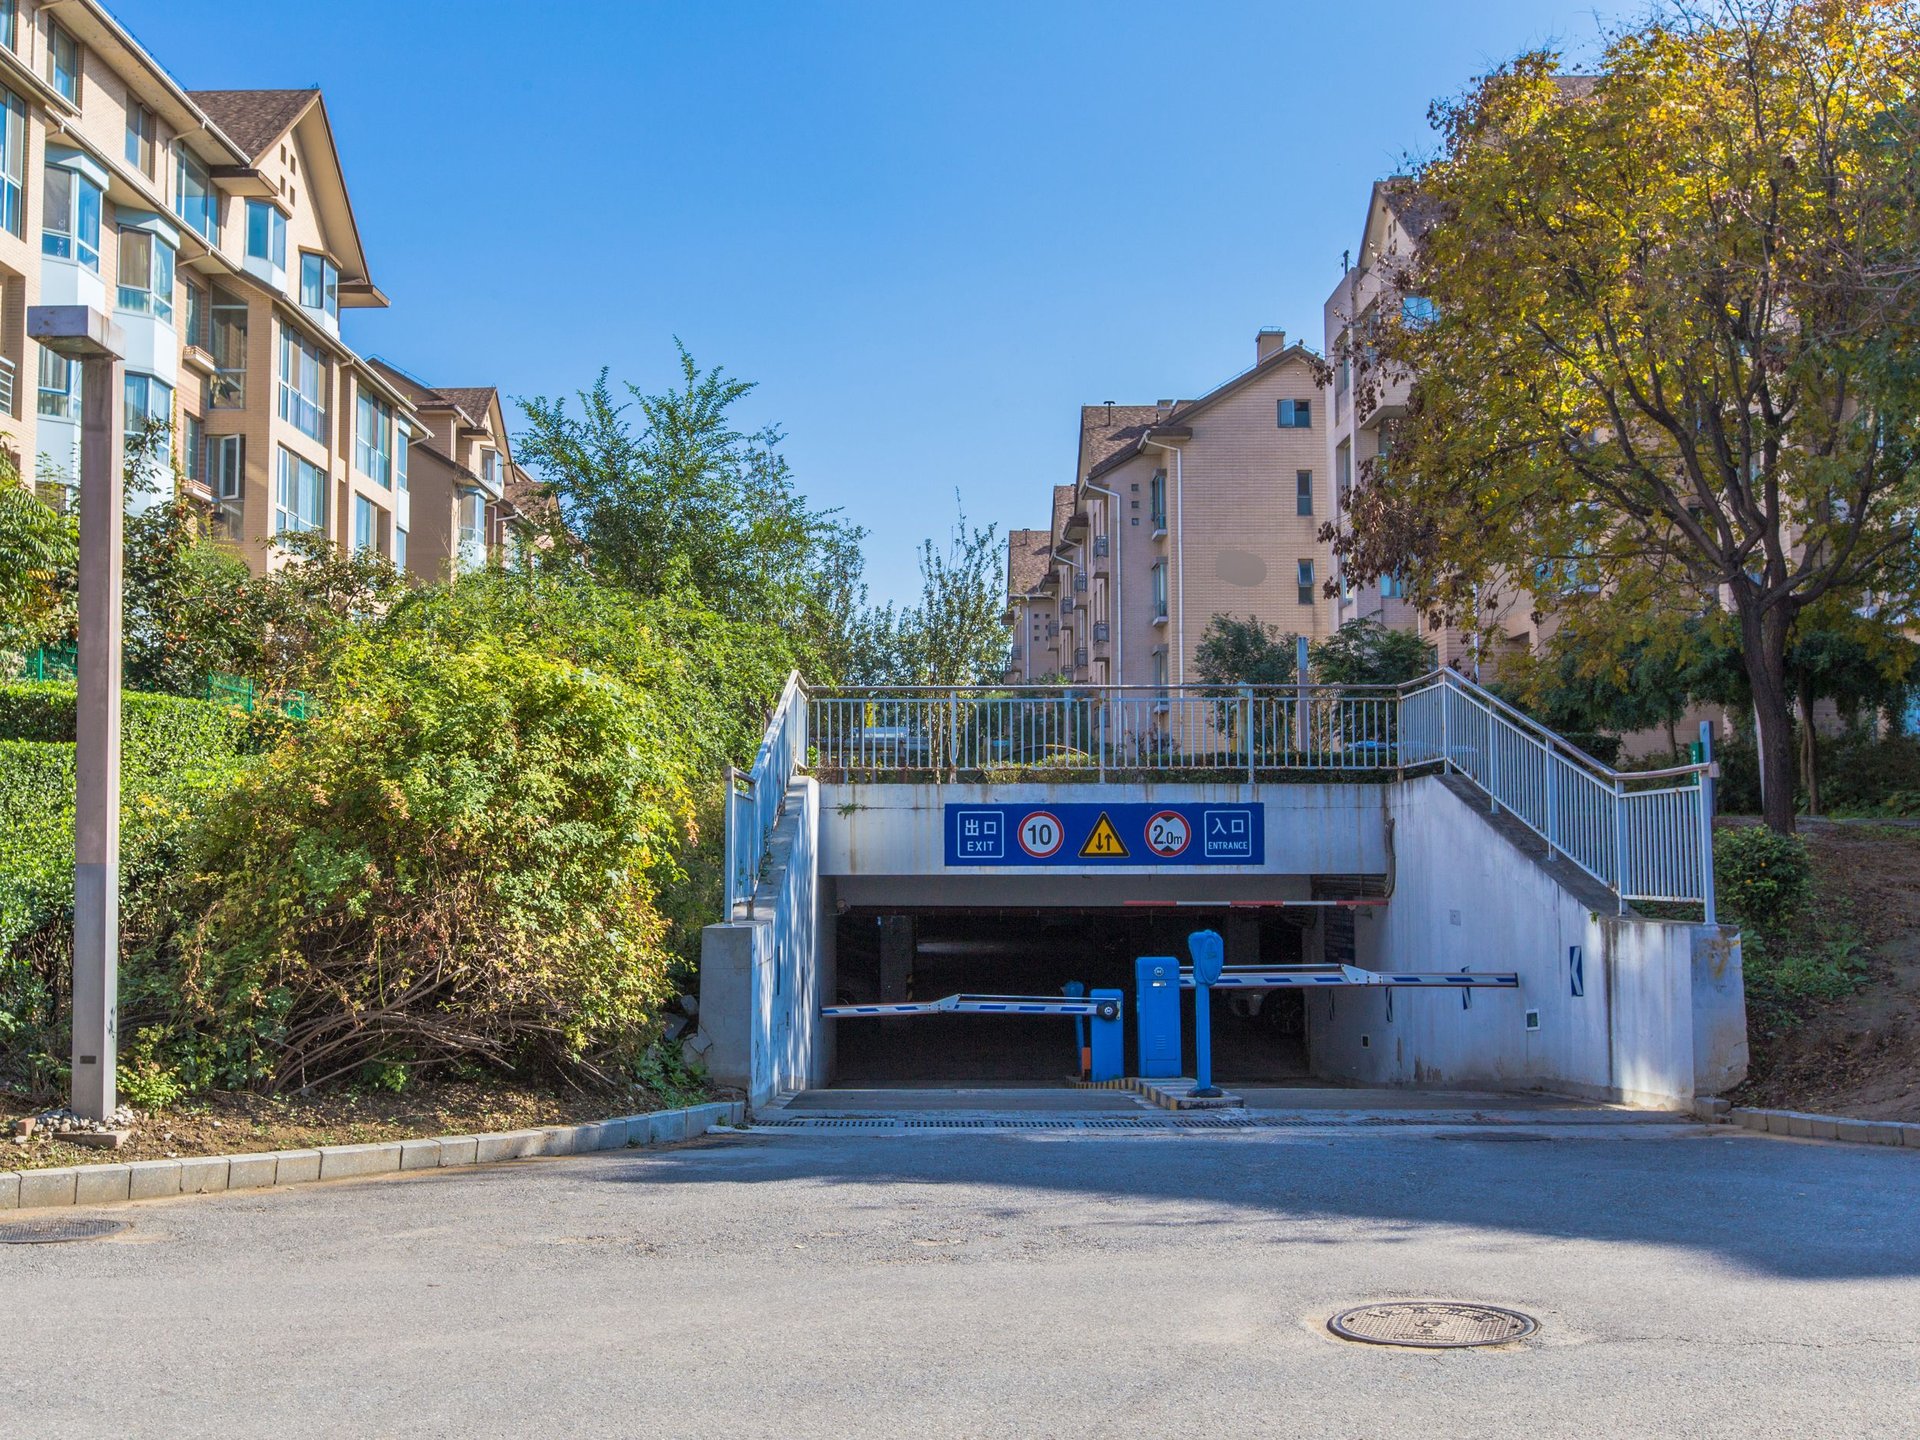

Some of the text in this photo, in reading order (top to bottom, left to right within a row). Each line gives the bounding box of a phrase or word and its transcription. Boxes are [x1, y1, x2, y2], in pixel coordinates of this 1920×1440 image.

[965, 819, 997, 836] 出口
[1028, 824, 1052, 845] 10
[1153, 824, 1183, 845] 2.0m
[1211, 817, 1244, 835] 入口
[967, 841, 994, 851] EXIT
[1208, 841, 1248, 850] ENTRANCE
